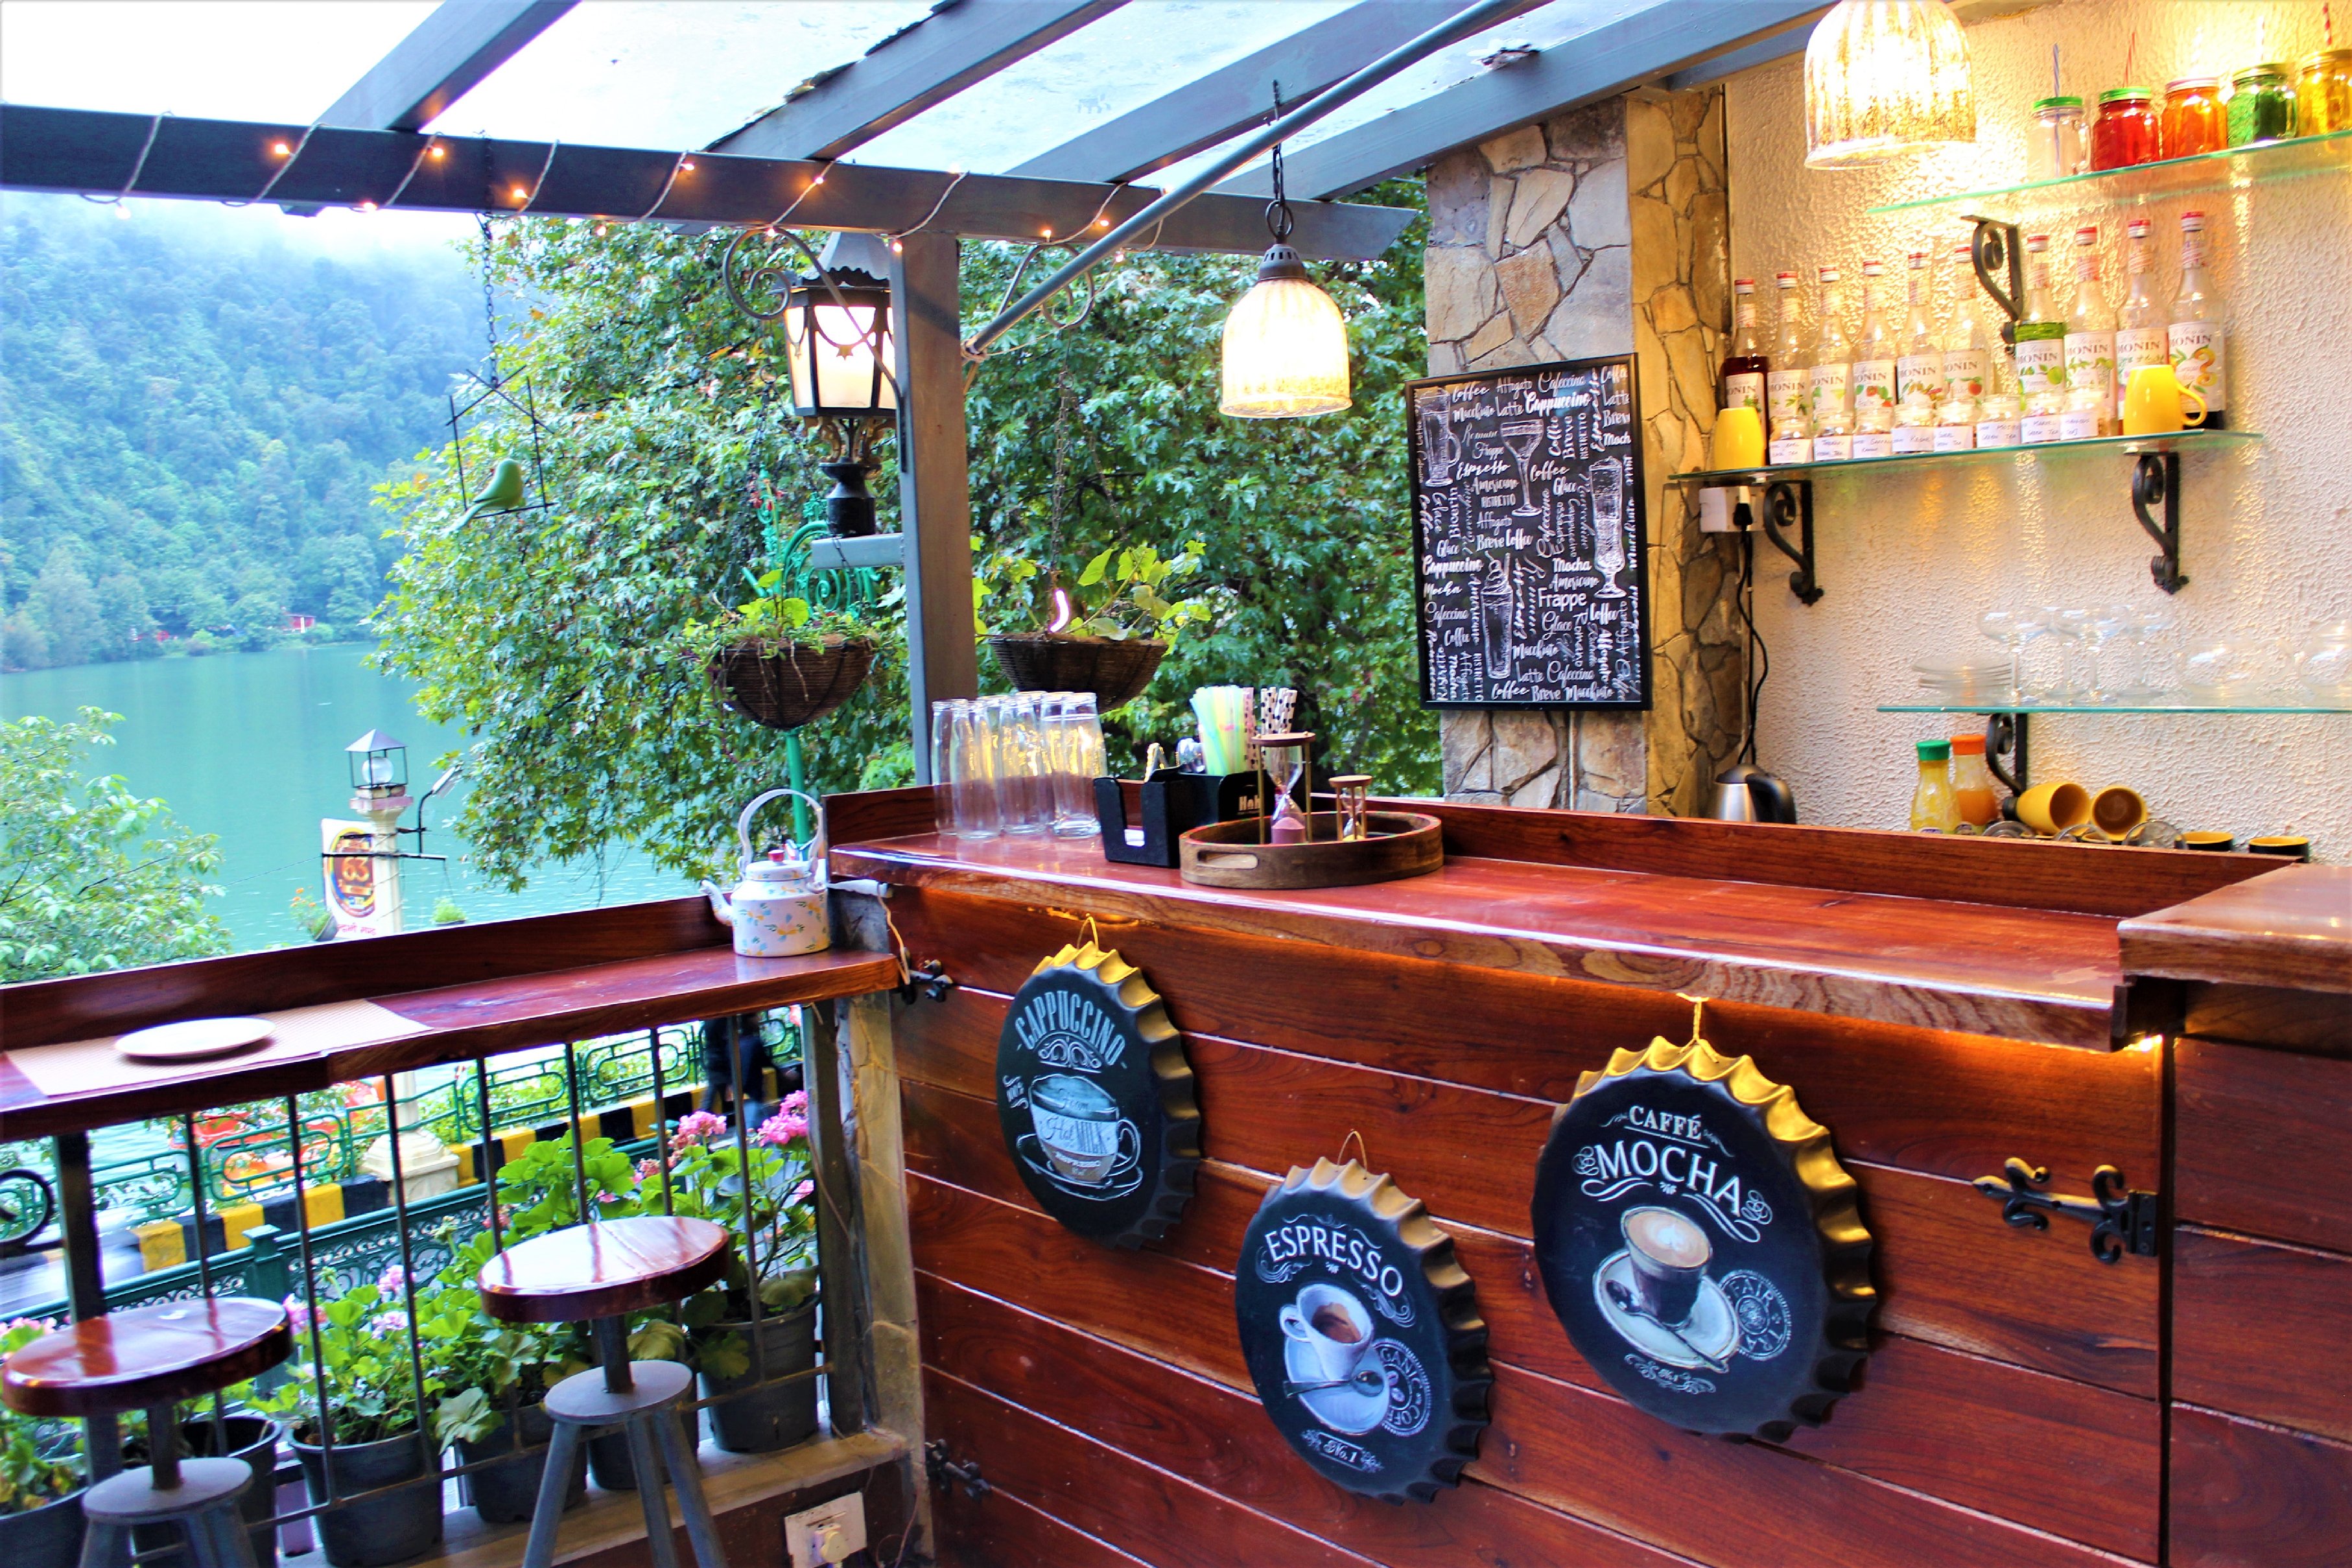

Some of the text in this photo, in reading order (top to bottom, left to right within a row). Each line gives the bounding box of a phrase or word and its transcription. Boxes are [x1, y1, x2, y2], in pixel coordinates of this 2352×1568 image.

[1728, 385, 1757, 395] ONIN
[1855, 372, 1887, 382] ONIN
[1452, 381, 1490, 403] Coffee
[1523, 390, 1591, 417] Cappuccino
[1494, 396, 1523, 417] Latte
[1602, 409, 1630, 429] Brev
[1546, 415, 1563, 457] Coffee
[1562, 415, 1576, 460] Breve
[1578, 412, 1590, 460] RISTRETTO
[1602, 431, 1632, 447] Moch
[1529, 460, 1571, 482] Coffee
[1431, 491, 1450, 535] Glace
[1481, 493, 1517, 509] RISTRETTO
[1476, 533, 1505, 552] Breve
[1422, 554, 1485, 580] Cappuccino
[1552, 556, 1592, 573] Mocha
[1537, 587, 1588, 613] Frappe
[1542, 611, 1573, 641] Glace
[1572, 607, 1589, 668] Romano
[1597, 627, 1614, 685] Affogato
[1473, 653, 1484, 701] RISTRETTO
[1515, 661, 1546, 683] Latte
[1492, 680, 1531, 700] Coffee
[1531, 685, 1561, 703] Breve
[1015, 990, 1127, 1068] CAPPUCCINO
[1628, 1105, 1702, 1141] CAFFÉ
[1593, 1139, 1742, 1217] MOCHA
[1265, 1224, 1405, 1298] ESPRESSO
[1728, 1278, 1775, 1308] FAIR
[1380, 1348, 1423, 1389] GANIC
[1387, 1405, 1420, 1426] COFF
